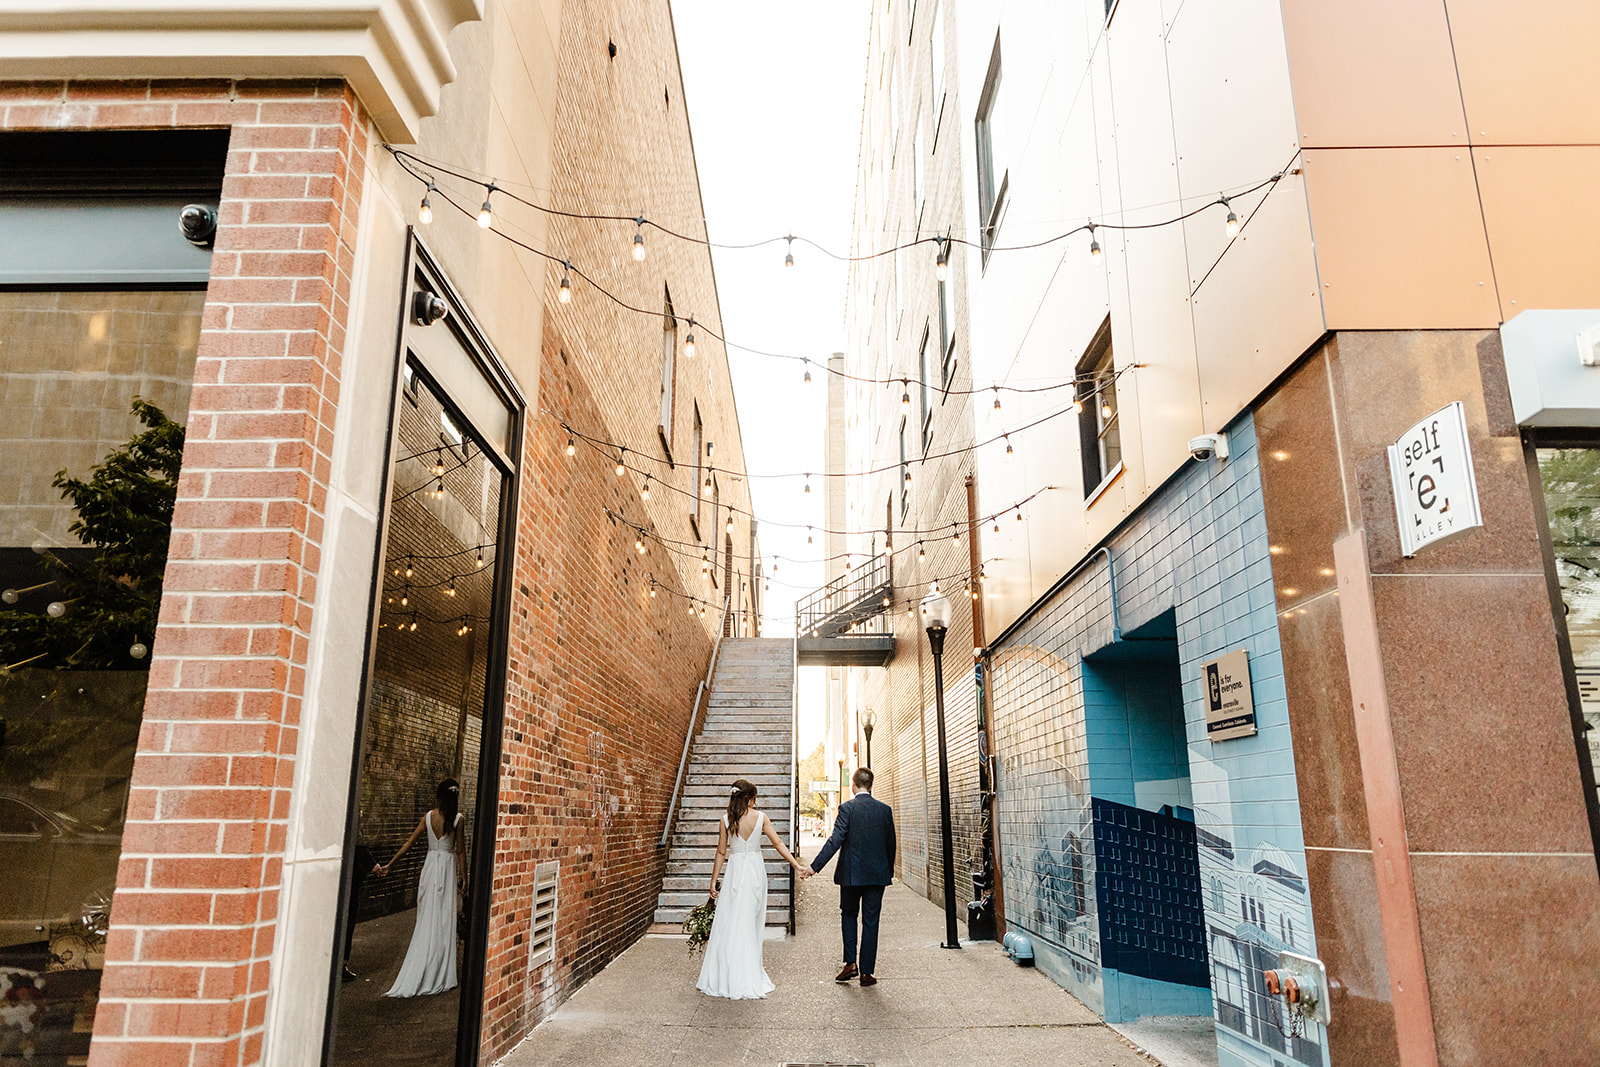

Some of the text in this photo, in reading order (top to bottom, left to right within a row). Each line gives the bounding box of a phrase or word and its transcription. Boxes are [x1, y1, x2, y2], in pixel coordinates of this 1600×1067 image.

[1404, 420, 1440, 467] self
[1417, 474, 1437, 510] e
[1416, 517, 1454, 541] ALLEY
[1224, 674, 1232, 683] for
